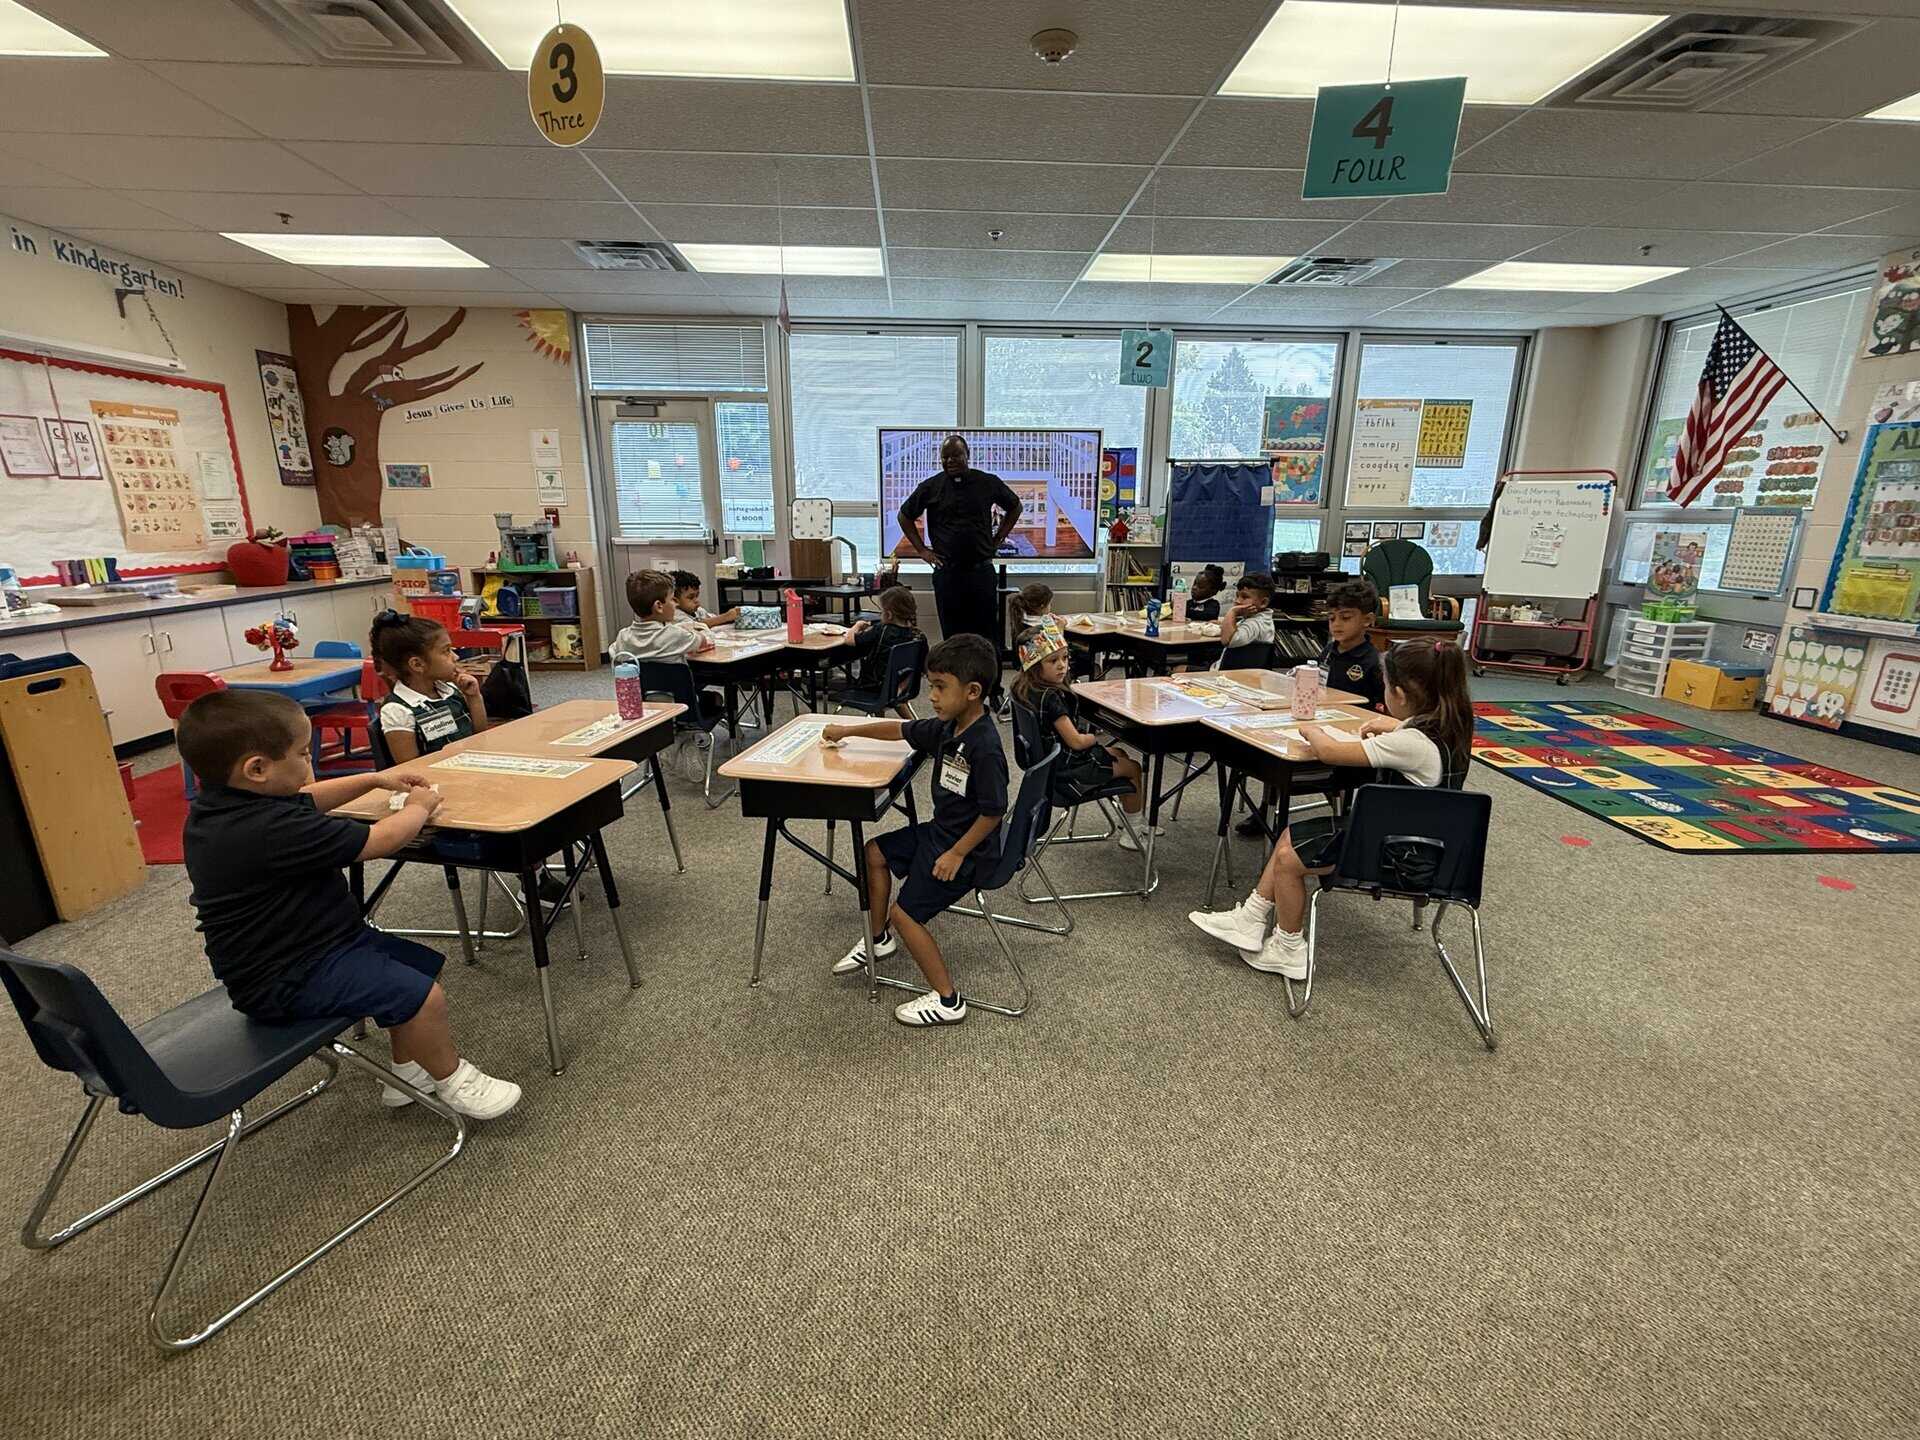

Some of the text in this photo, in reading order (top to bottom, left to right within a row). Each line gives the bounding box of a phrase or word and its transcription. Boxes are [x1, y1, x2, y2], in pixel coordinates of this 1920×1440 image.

[549, 42, 578, 103] 3
[539, 110, 585, 133] Three
[1352, 96, 1395, 149] 4
[1331, 155, 1407, 184] FOUR
[11, 227, 184, 299] in Kindergarten!
[1135, 341, 1154, 368] 2
[1131, 368, 1153, 384] two
[406, 395, 512, 420] Jesus Gives Us Life
